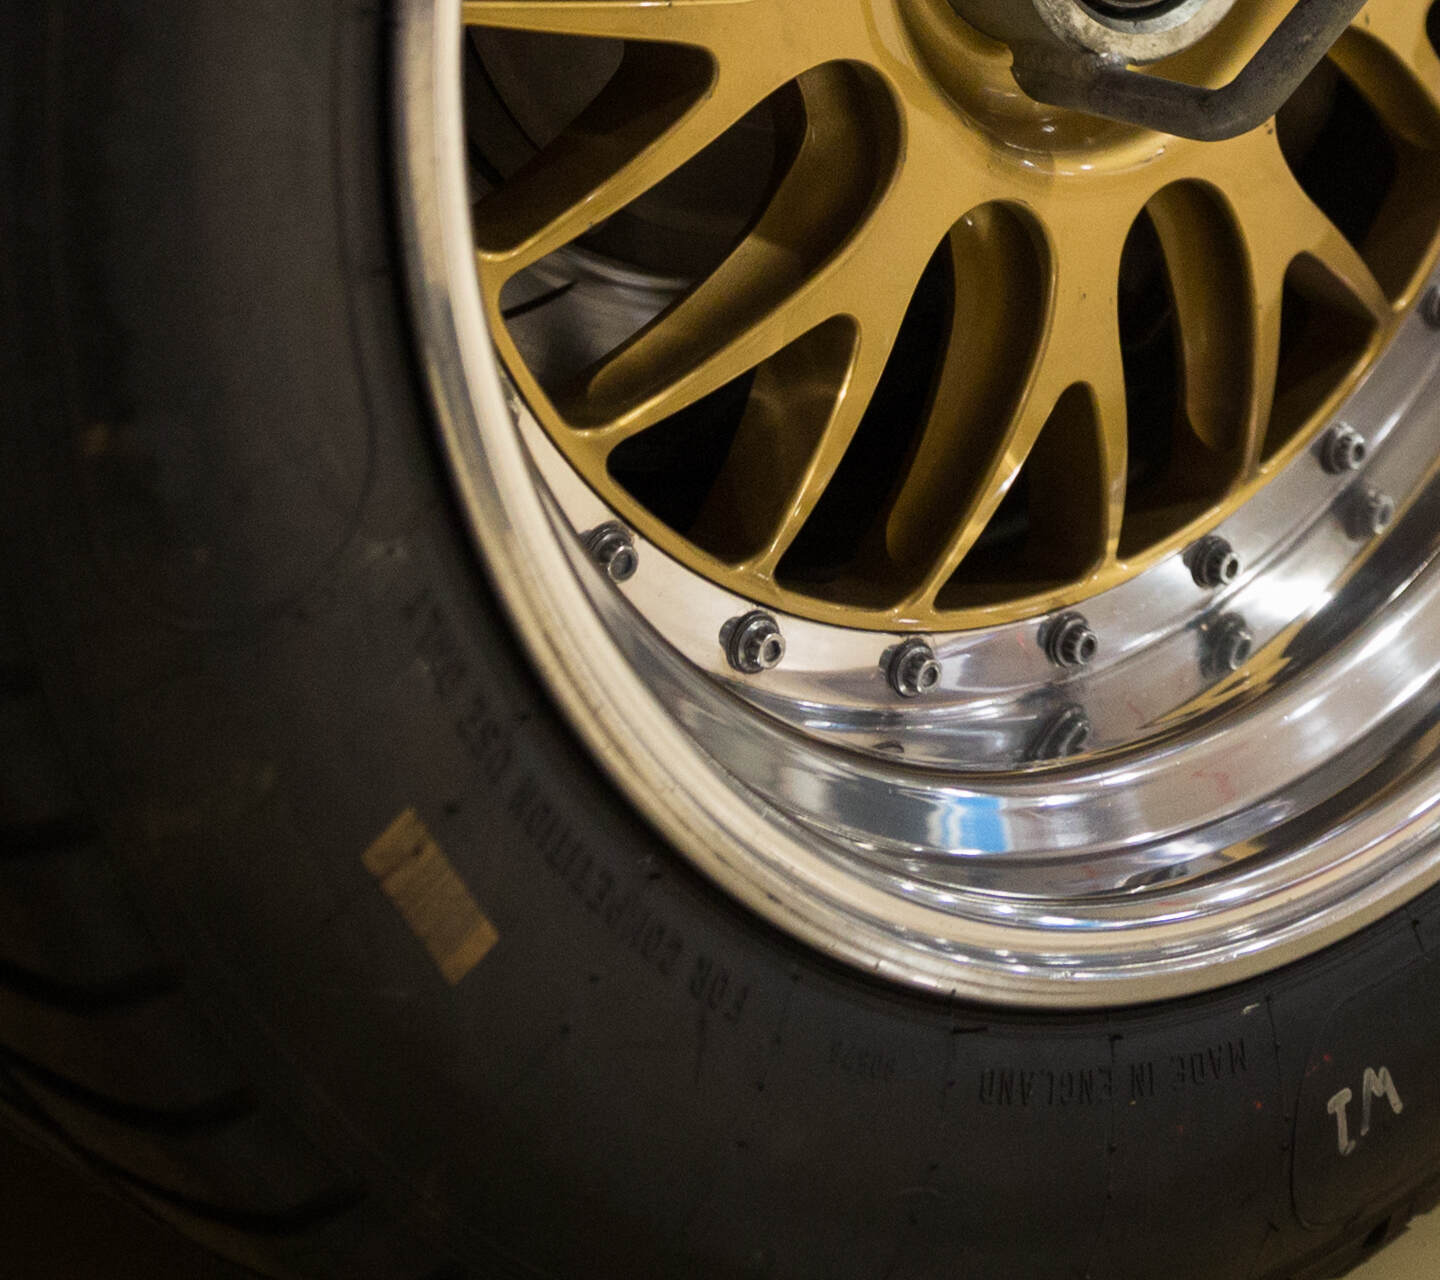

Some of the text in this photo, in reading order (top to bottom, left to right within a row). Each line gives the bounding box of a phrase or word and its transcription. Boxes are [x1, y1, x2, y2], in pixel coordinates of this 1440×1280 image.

[977, 1037, 1248, 1107] MADE IN ENGLAND
